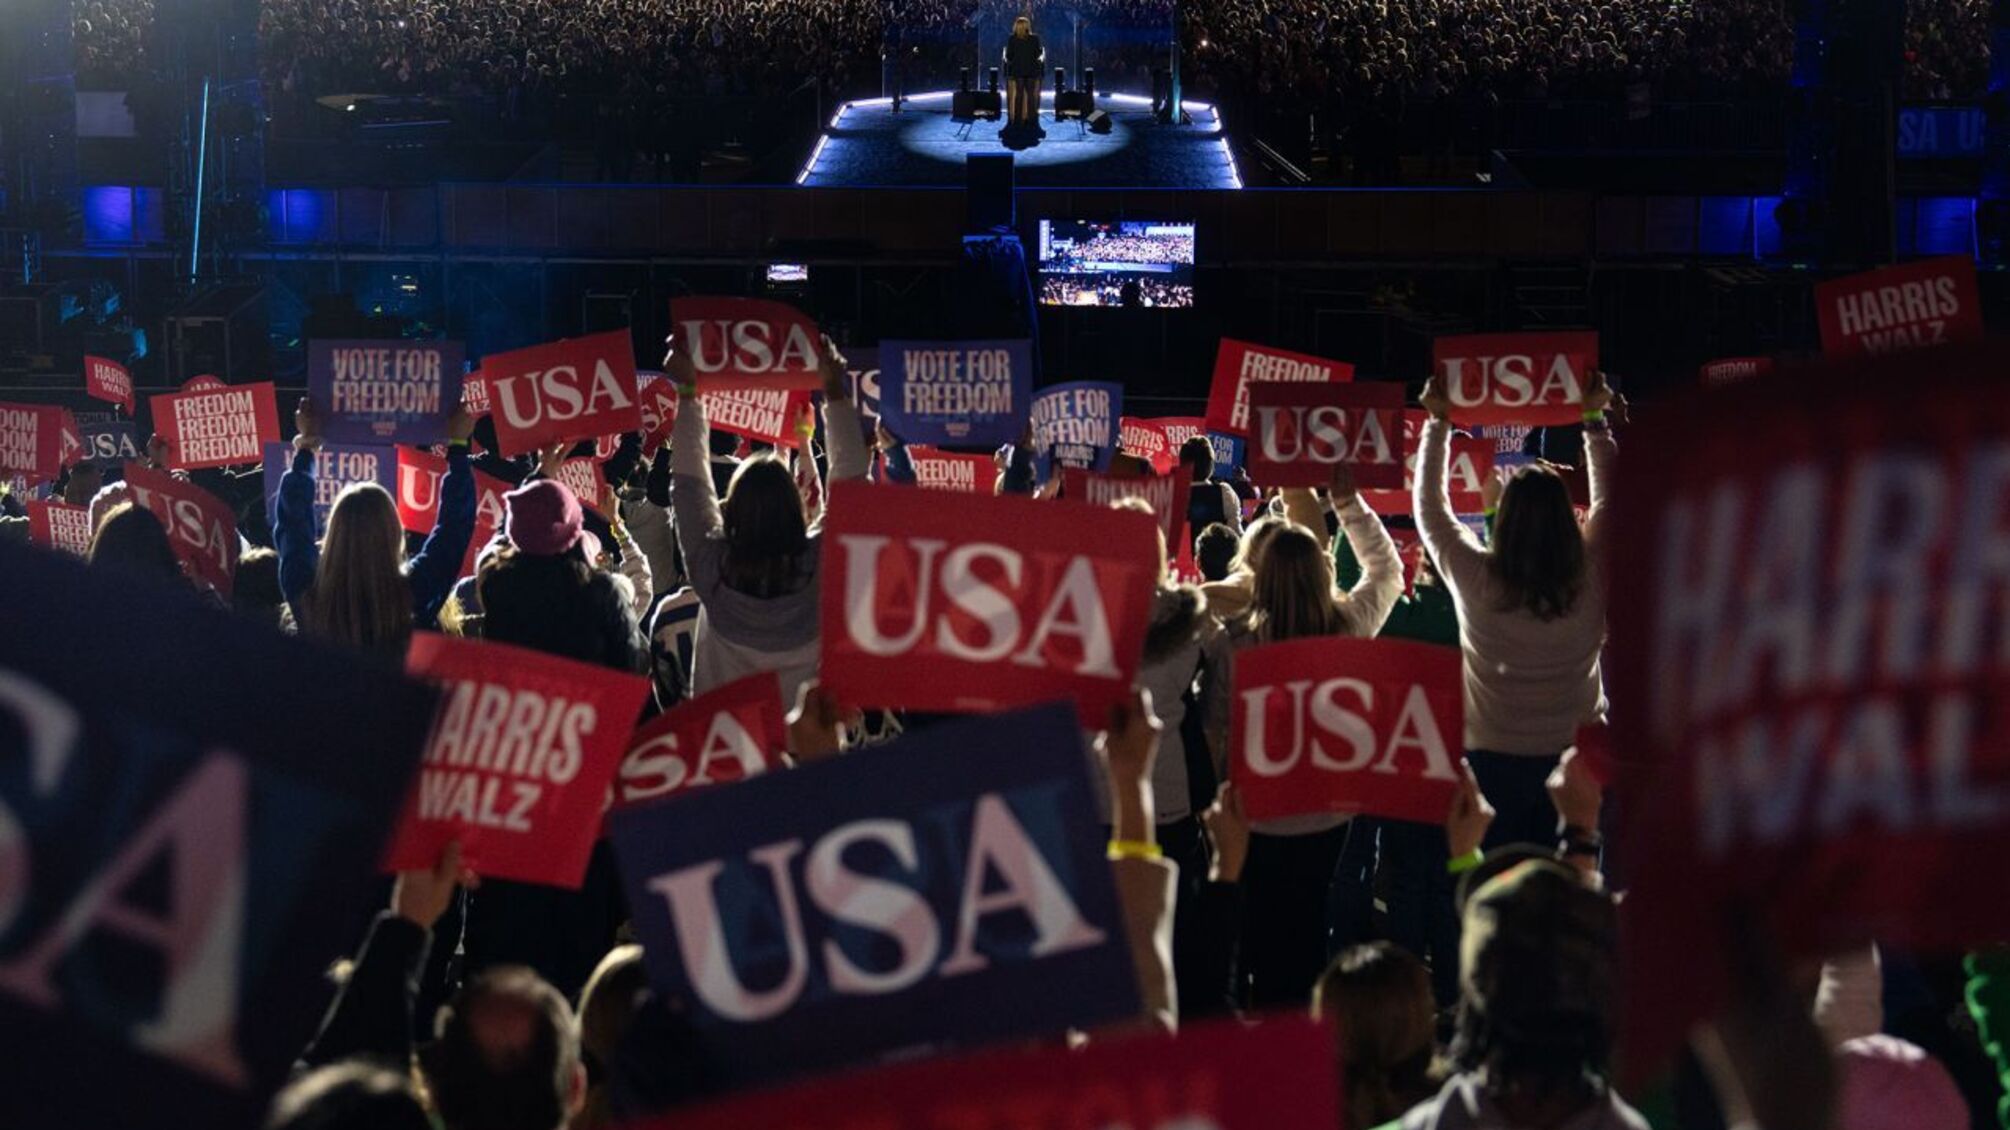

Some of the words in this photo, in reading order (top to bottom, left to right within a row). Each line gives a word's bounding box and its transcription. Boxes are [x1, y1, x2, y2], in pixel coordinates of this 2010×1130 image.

[1837, 275, 1960, 336] HARRIS
[332, 349, 389, 381] VOTE
[395, 350, 441, 381] FOR
[682, 320, 819, 374] USA
[904, 349, 961, 381] VOTE
[967, 349, 1010, 381] FOR
[332, 380, 440, 413] FREEDOM
[493, 358, 632, 429] USA
[904, 382, 1012, 414] FREEDOM
[1442, 353, 1583, 407] USA
[174, 390, 254, 420] FREEDOM
[177, 412, 257, 441] FREEDOM
[1031, 391, 1072, 424] VOTE
[1075, 388, 1110, 418] FOR
[180, 434, 260, 464] FREEDOM
[1032, 417, 1110, 457] FREEDOM
[1256, 405, 1398, 464] USA
[338, 451, 379, 482] FOR
[838, 533, 1123, 679] USA
[424, 679, 598, 785] ARRIS
[1240, 676, 1461, 783] USA
[417, 768, 543, 833] WALZ
[645, 793, 1108, 1022] USA
